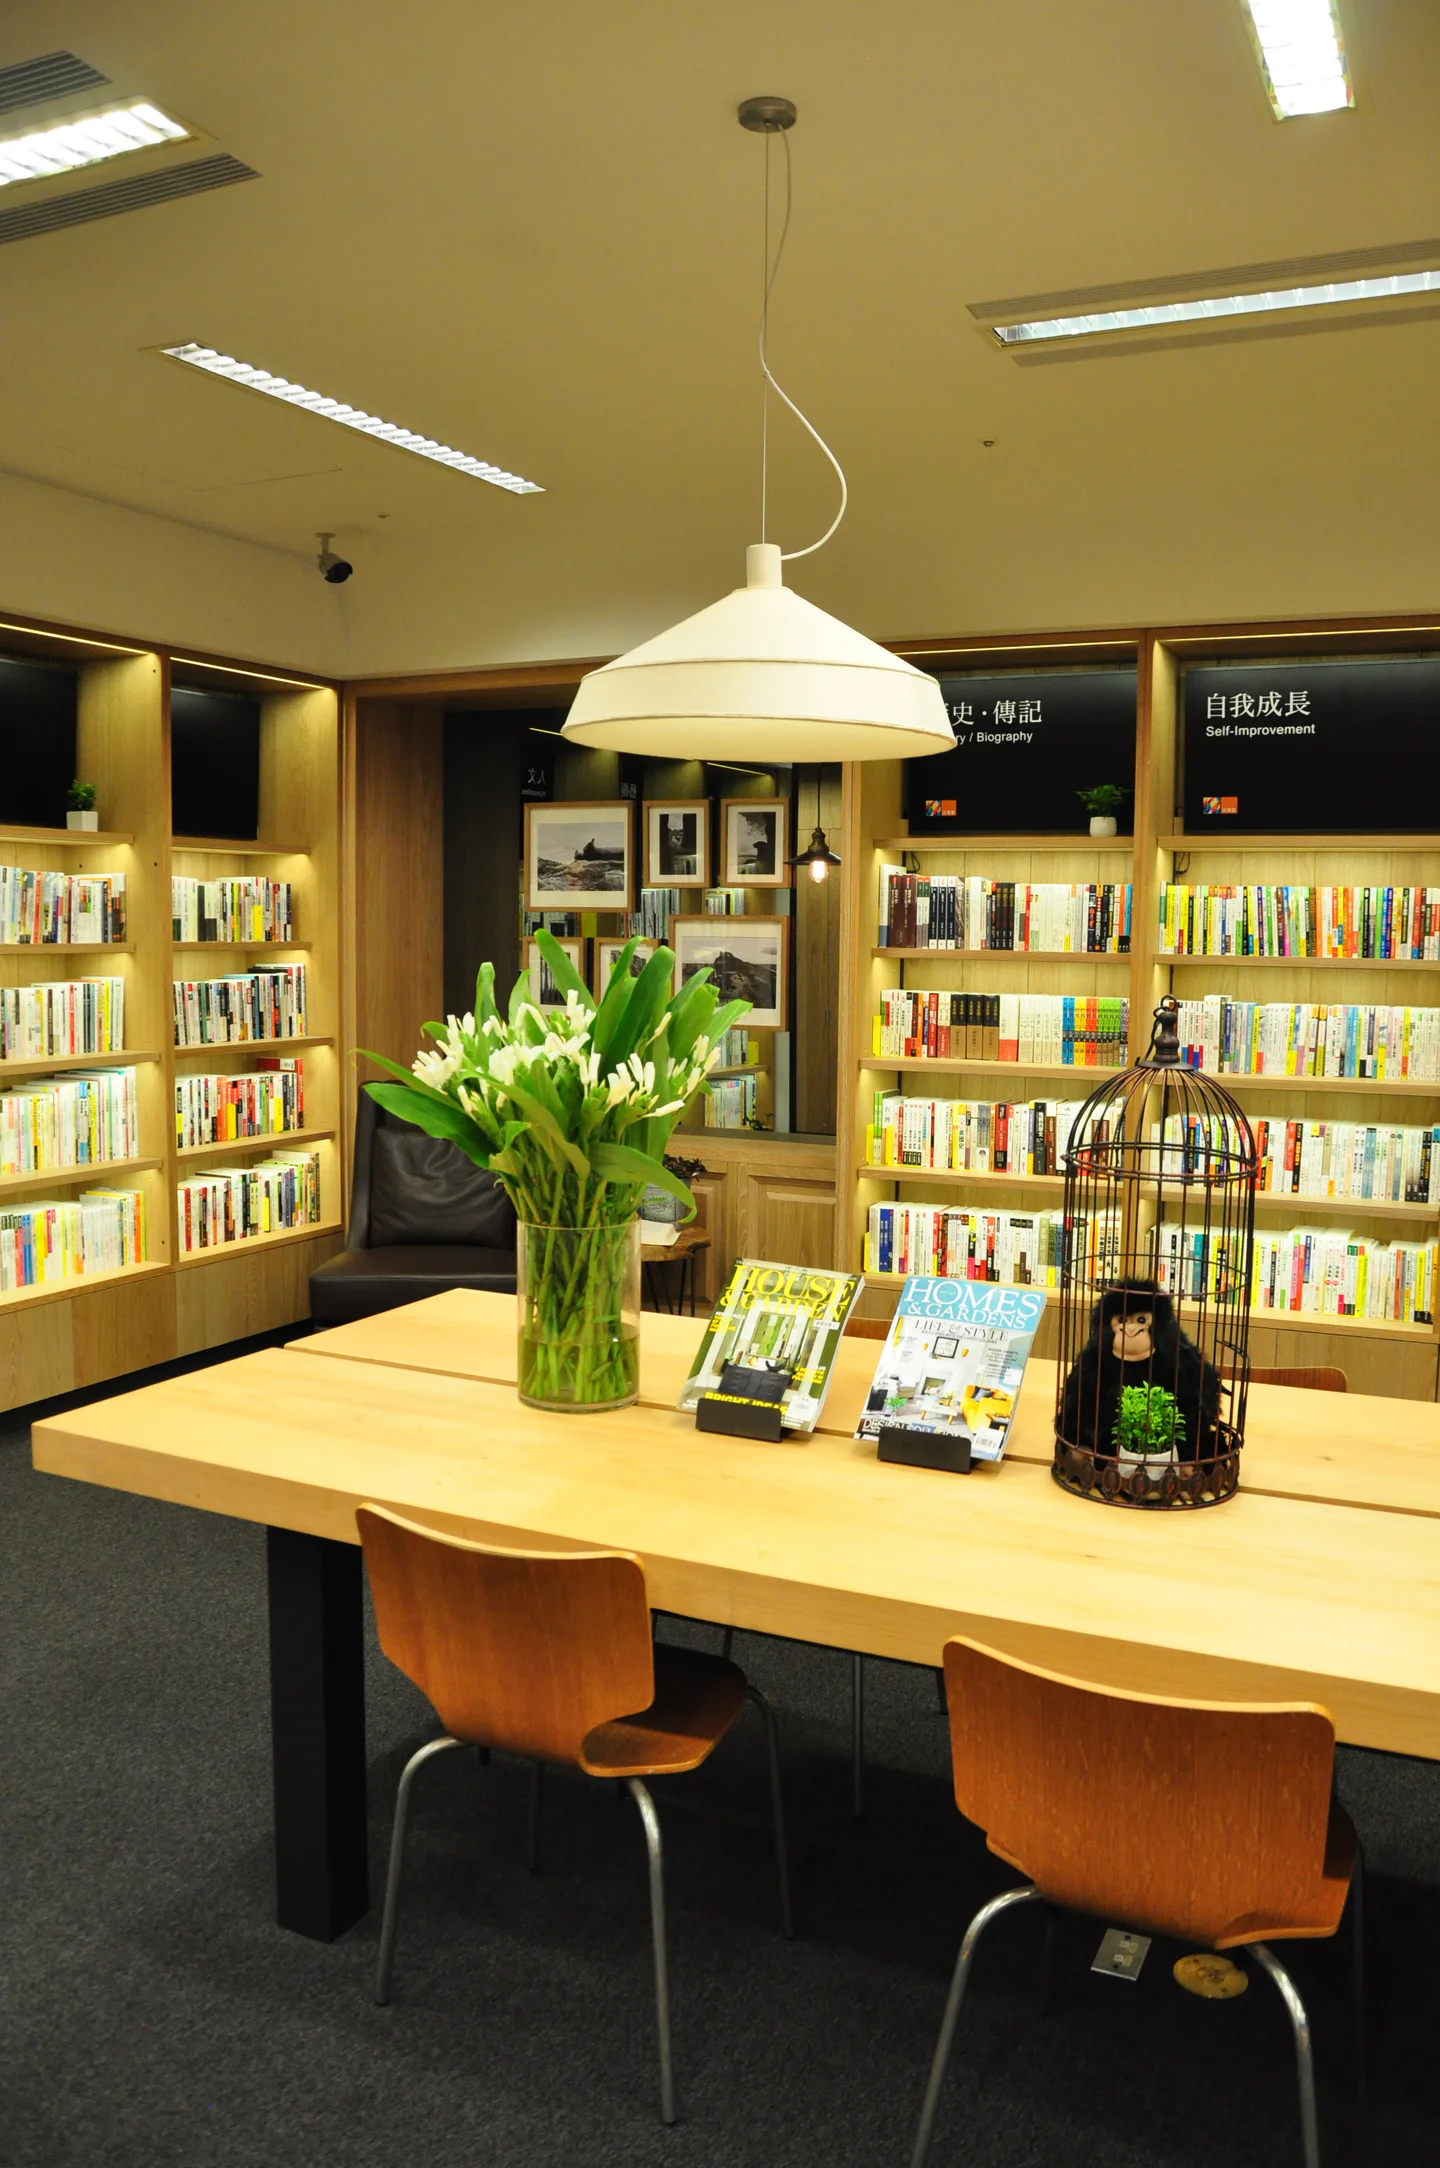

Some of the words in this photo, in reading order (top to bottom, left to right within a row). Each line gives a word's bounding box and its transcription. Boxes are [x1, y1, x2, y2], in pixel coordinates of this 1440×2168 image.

[944, 699, 1043, 727] 史·傳記
[1206, 690, 1311, 719] 自我成長
[976, 731, 1034, 744] Biography
[1205, 723, 1316, 738] Self-Improvement
[725, 1264, 856, 1306] HOUSE
[903, 1278, 1041, 1317] HOMES
[719, 1289, 735, 1307] &
[740, 1291, 847, 1322] GARDEN
[907, 1301, 922, 1316] &
[925, 1302, 1028, 1330] GARDENS
[914, 1319, 946, 1333] LIFE
[962, 1325, 1009, 1343] STYLE
